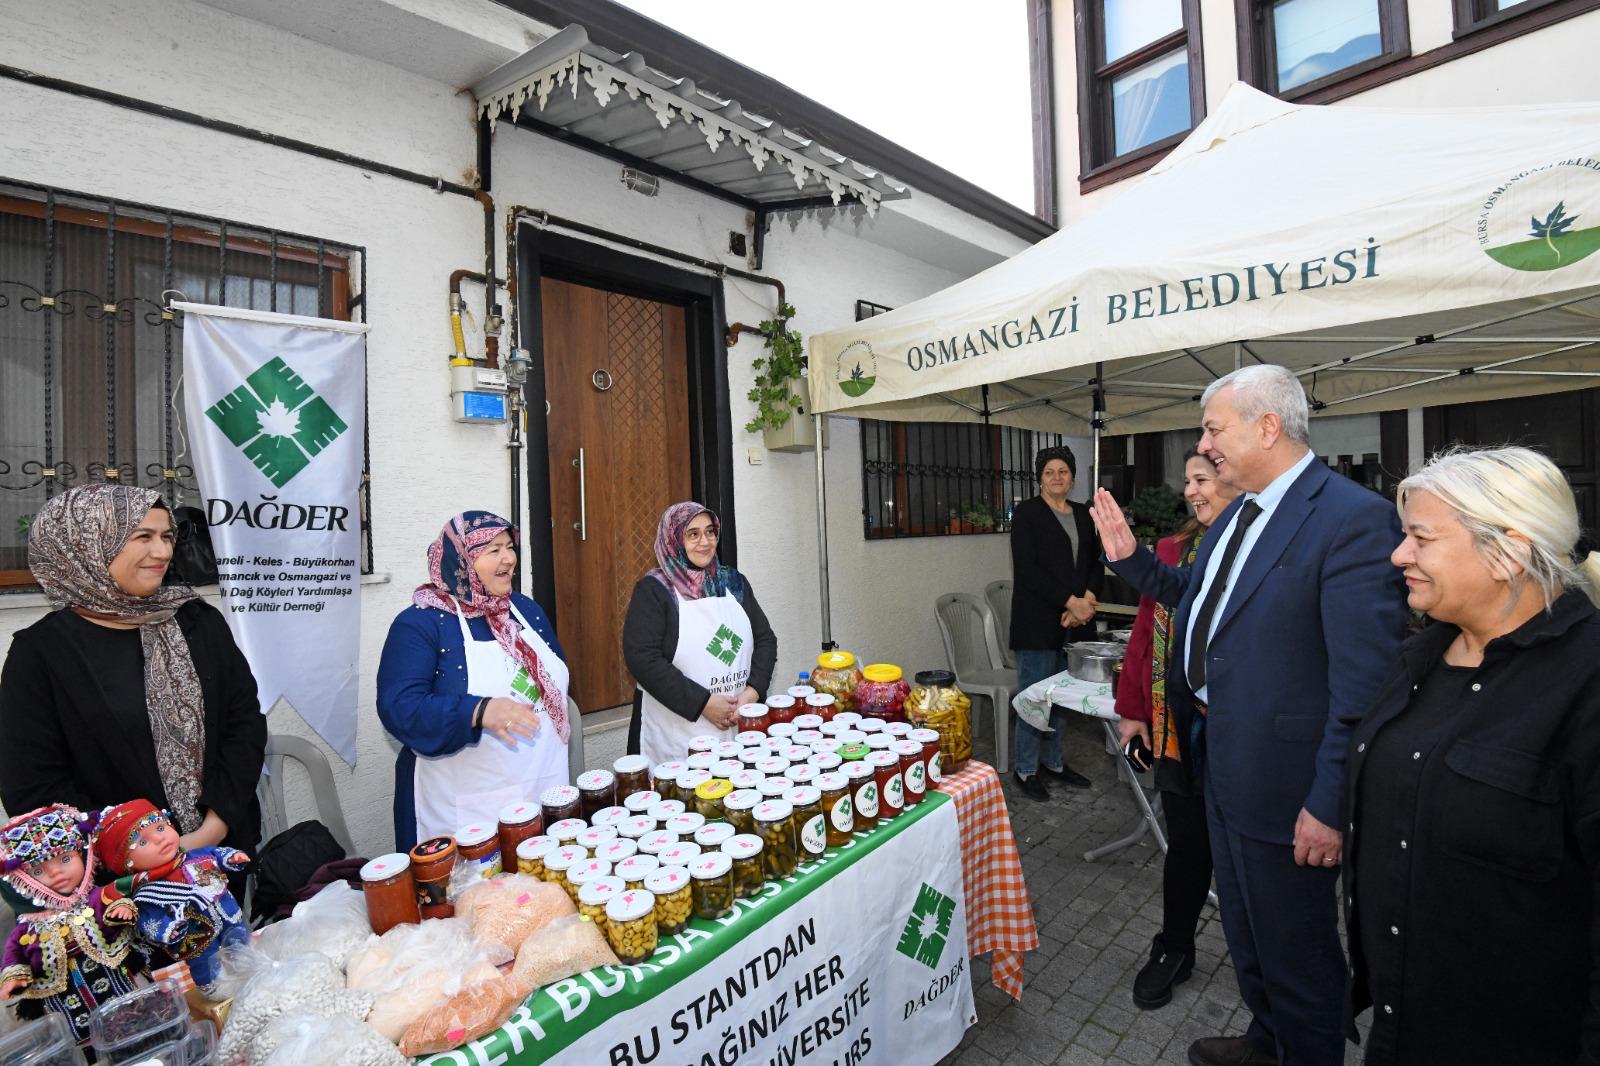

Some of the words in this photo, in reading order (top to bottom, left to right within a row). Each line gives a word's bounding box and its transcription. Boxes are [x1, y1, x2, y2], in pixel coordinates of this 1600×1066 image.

[906, 295, 1080, 372] OSMANGAZİ
[206, 494, 349, 532] DAĞDER
[253, 556, 283, 566] Keles
[293, 557, 355, 568] Büyükorhan
[278, 572, 337, 584] Osmangazi
[340, 573, 351, 581] ve
[230, 587, 253, 599] Dağ
[256, 586, 293, 599] Köyleri
[248, 602, 281, 612] Kültür
[283, 602, 325, 613] Derneği
[609, 1026, 660, 1066] BU
[670, 917, 816, 1044] STANTDAN
[794, 955, 845, 1008] HER
[903, 957, 964, 1021] DAĞDER
